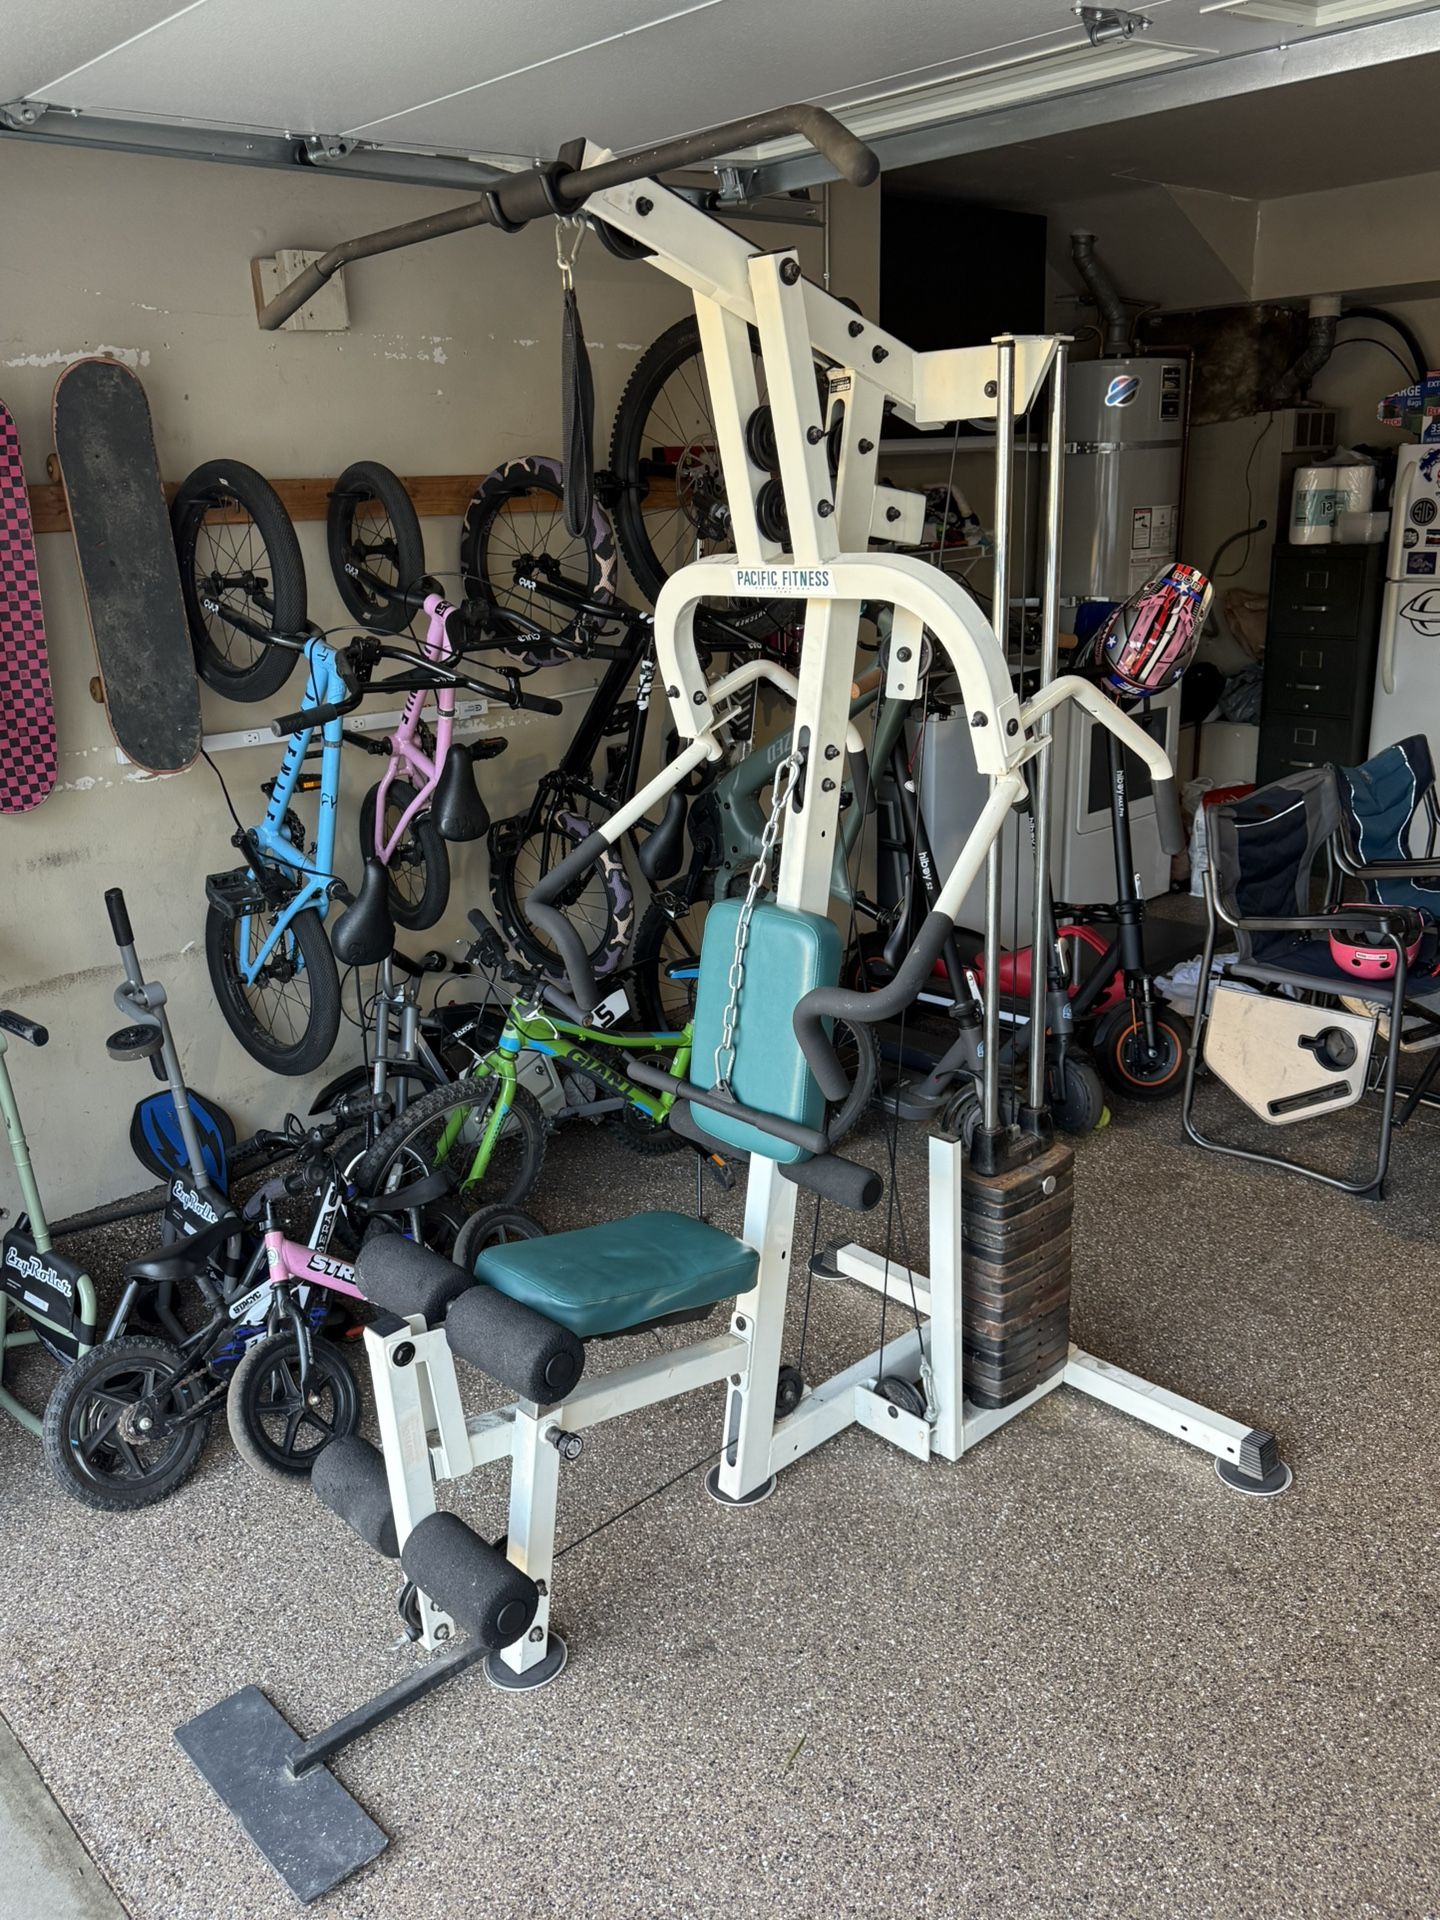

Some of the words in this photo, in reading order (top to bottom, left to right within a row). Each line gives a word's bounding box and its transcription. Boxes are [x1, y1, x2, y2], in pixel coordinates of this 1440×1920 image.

[737, 570, 778, 587] PACIFIC
[782, 571, 829, 587] FITNESS
[918, 851, 932, 880] hiboy
[567, 1048, 638, 1102] GIANT
[5, 1246, 72, 1298] EzyRoller
[232, 1290, 262, 1314] STACYC
